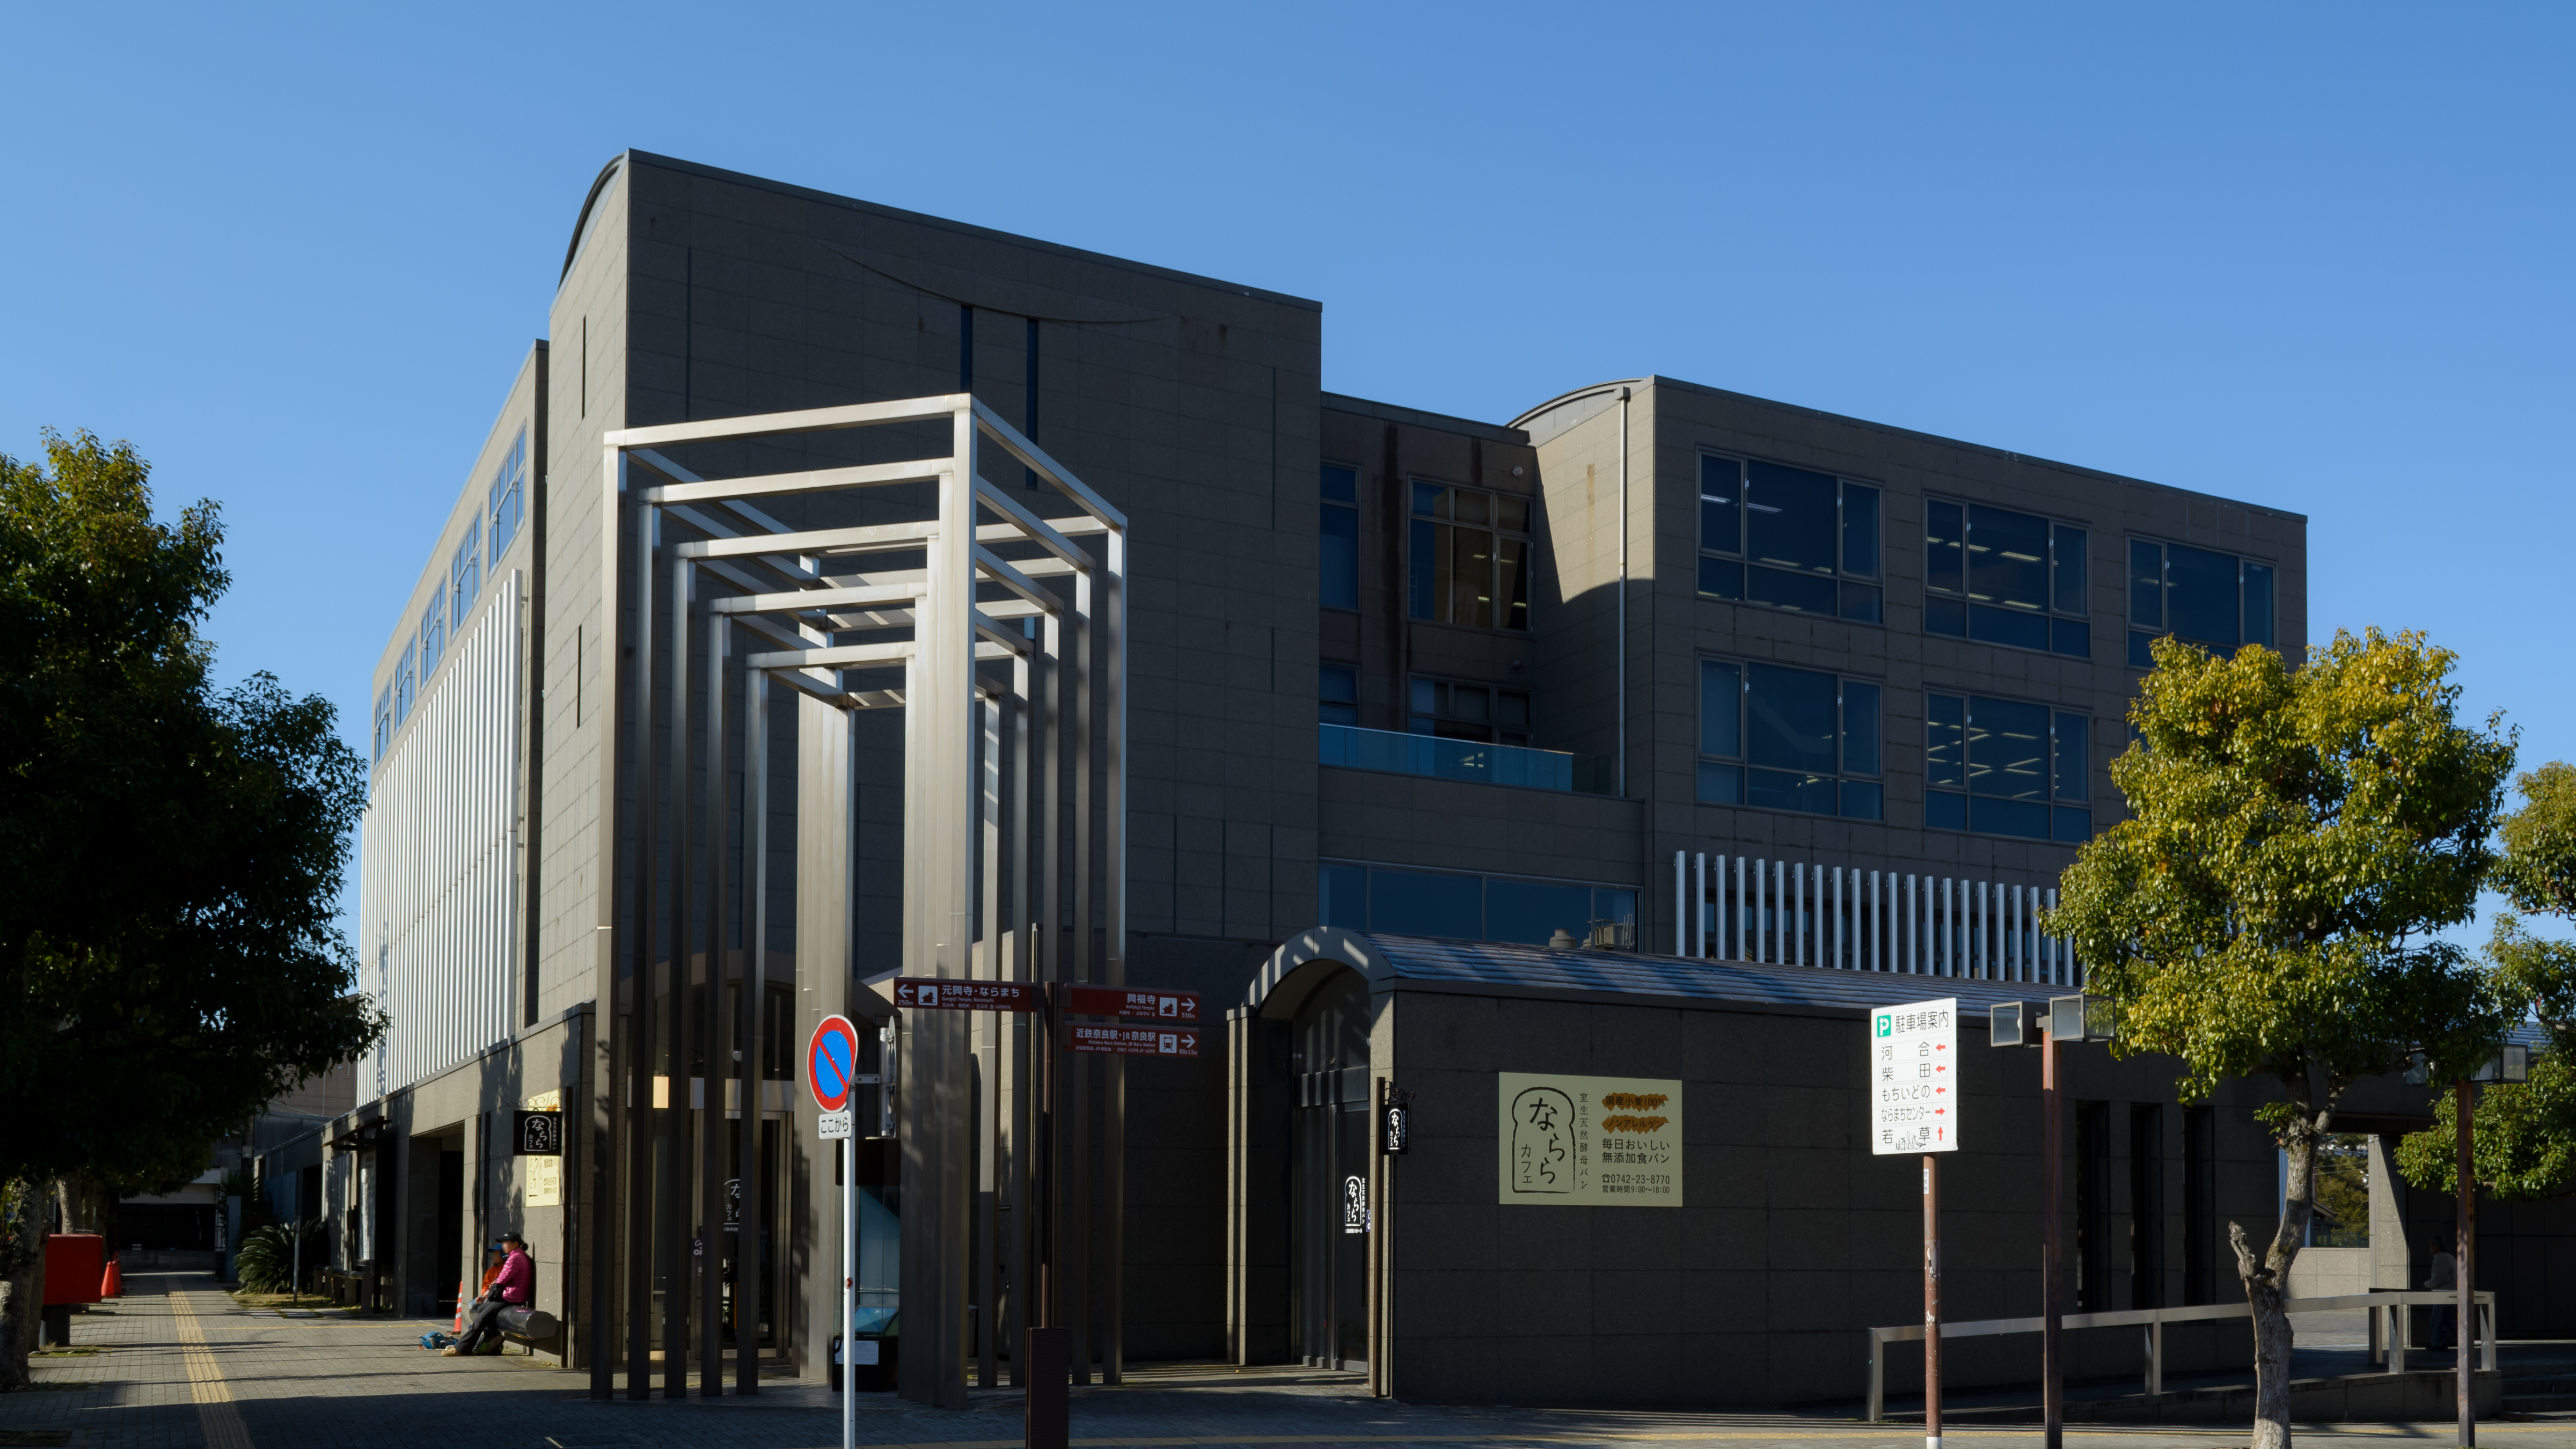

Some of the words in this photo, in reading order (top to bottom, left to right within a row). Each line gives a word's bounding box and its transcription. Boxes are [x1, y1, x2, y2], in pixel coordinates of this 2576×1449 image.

[942, 985, 1019, 997] 元興寺・ならまち
[1127, 994, 1156, 1005] 興福寺
[1896, 1009, 1949, 1034] 駐車場案内
[1882, 1085, 1930, 1102] もちいどの
[1882, 1106, 1930, 1122] ならまちセンター
[821, 1117, 848, 1133] ここから
[1608, 1118, 1664, 1129] ノンアレルゲン
[1579, 1093, 1589, 1190] 室生天然酵母パン
[1602, 1138, 1670, 1151] 毎日おいしい
[1521, 1144, 1533, 1184] カフェ
[1602, 1152, 1670, 1165] 無添加食パン
